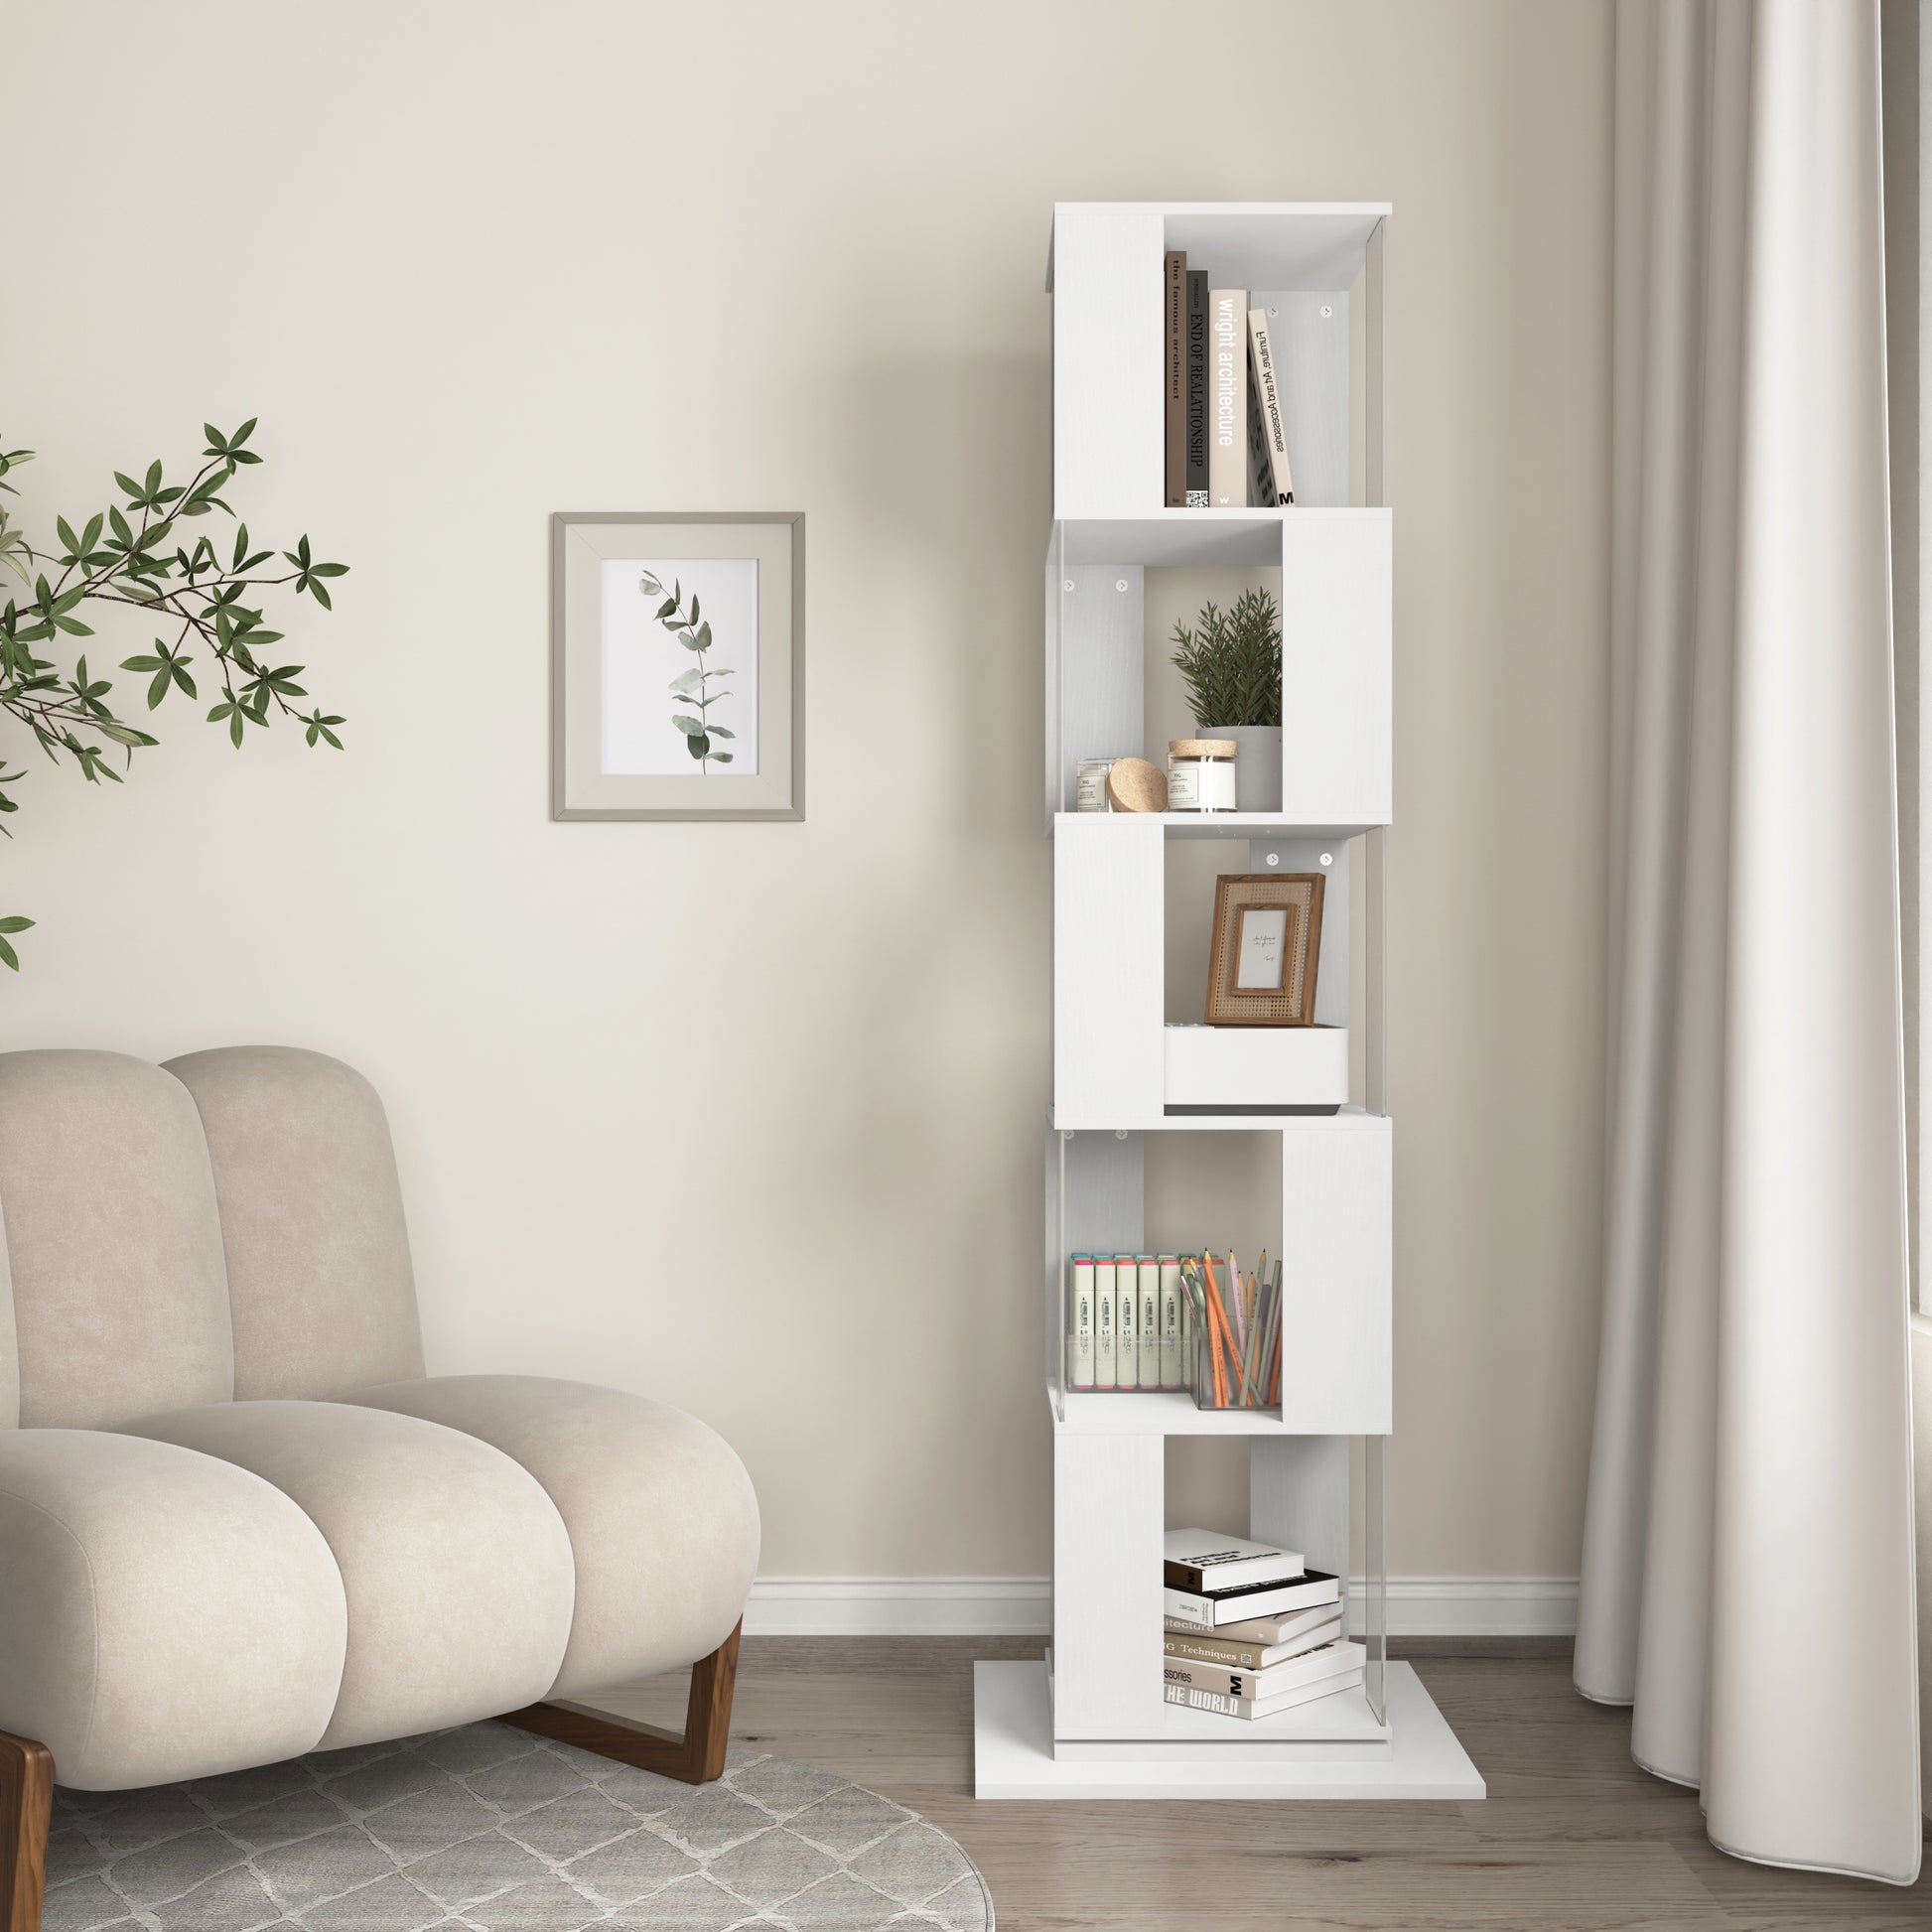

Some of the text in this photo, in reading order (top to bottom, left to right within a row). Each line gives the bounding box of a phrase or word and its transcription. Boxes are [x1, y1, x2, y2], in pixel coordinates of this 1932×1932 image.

[1190, 314, 1204, 342] END
[1190, 345, 1204, 360] OF
[1214, 299, 1238, 446] wright architecture
[1190, 364, 1204, 468] REALATIONSHIP
[1279, 491, 1295, 505] M
[1187, 1572, 1195, 1585] M
[1164, 1617, 1215, 1632] itecture
[1180, 1643, 1237, 1661] Techniques
[1230, 1675, 1242, 1697] M
[1188, 1689, 1239, 1716] WORLD
